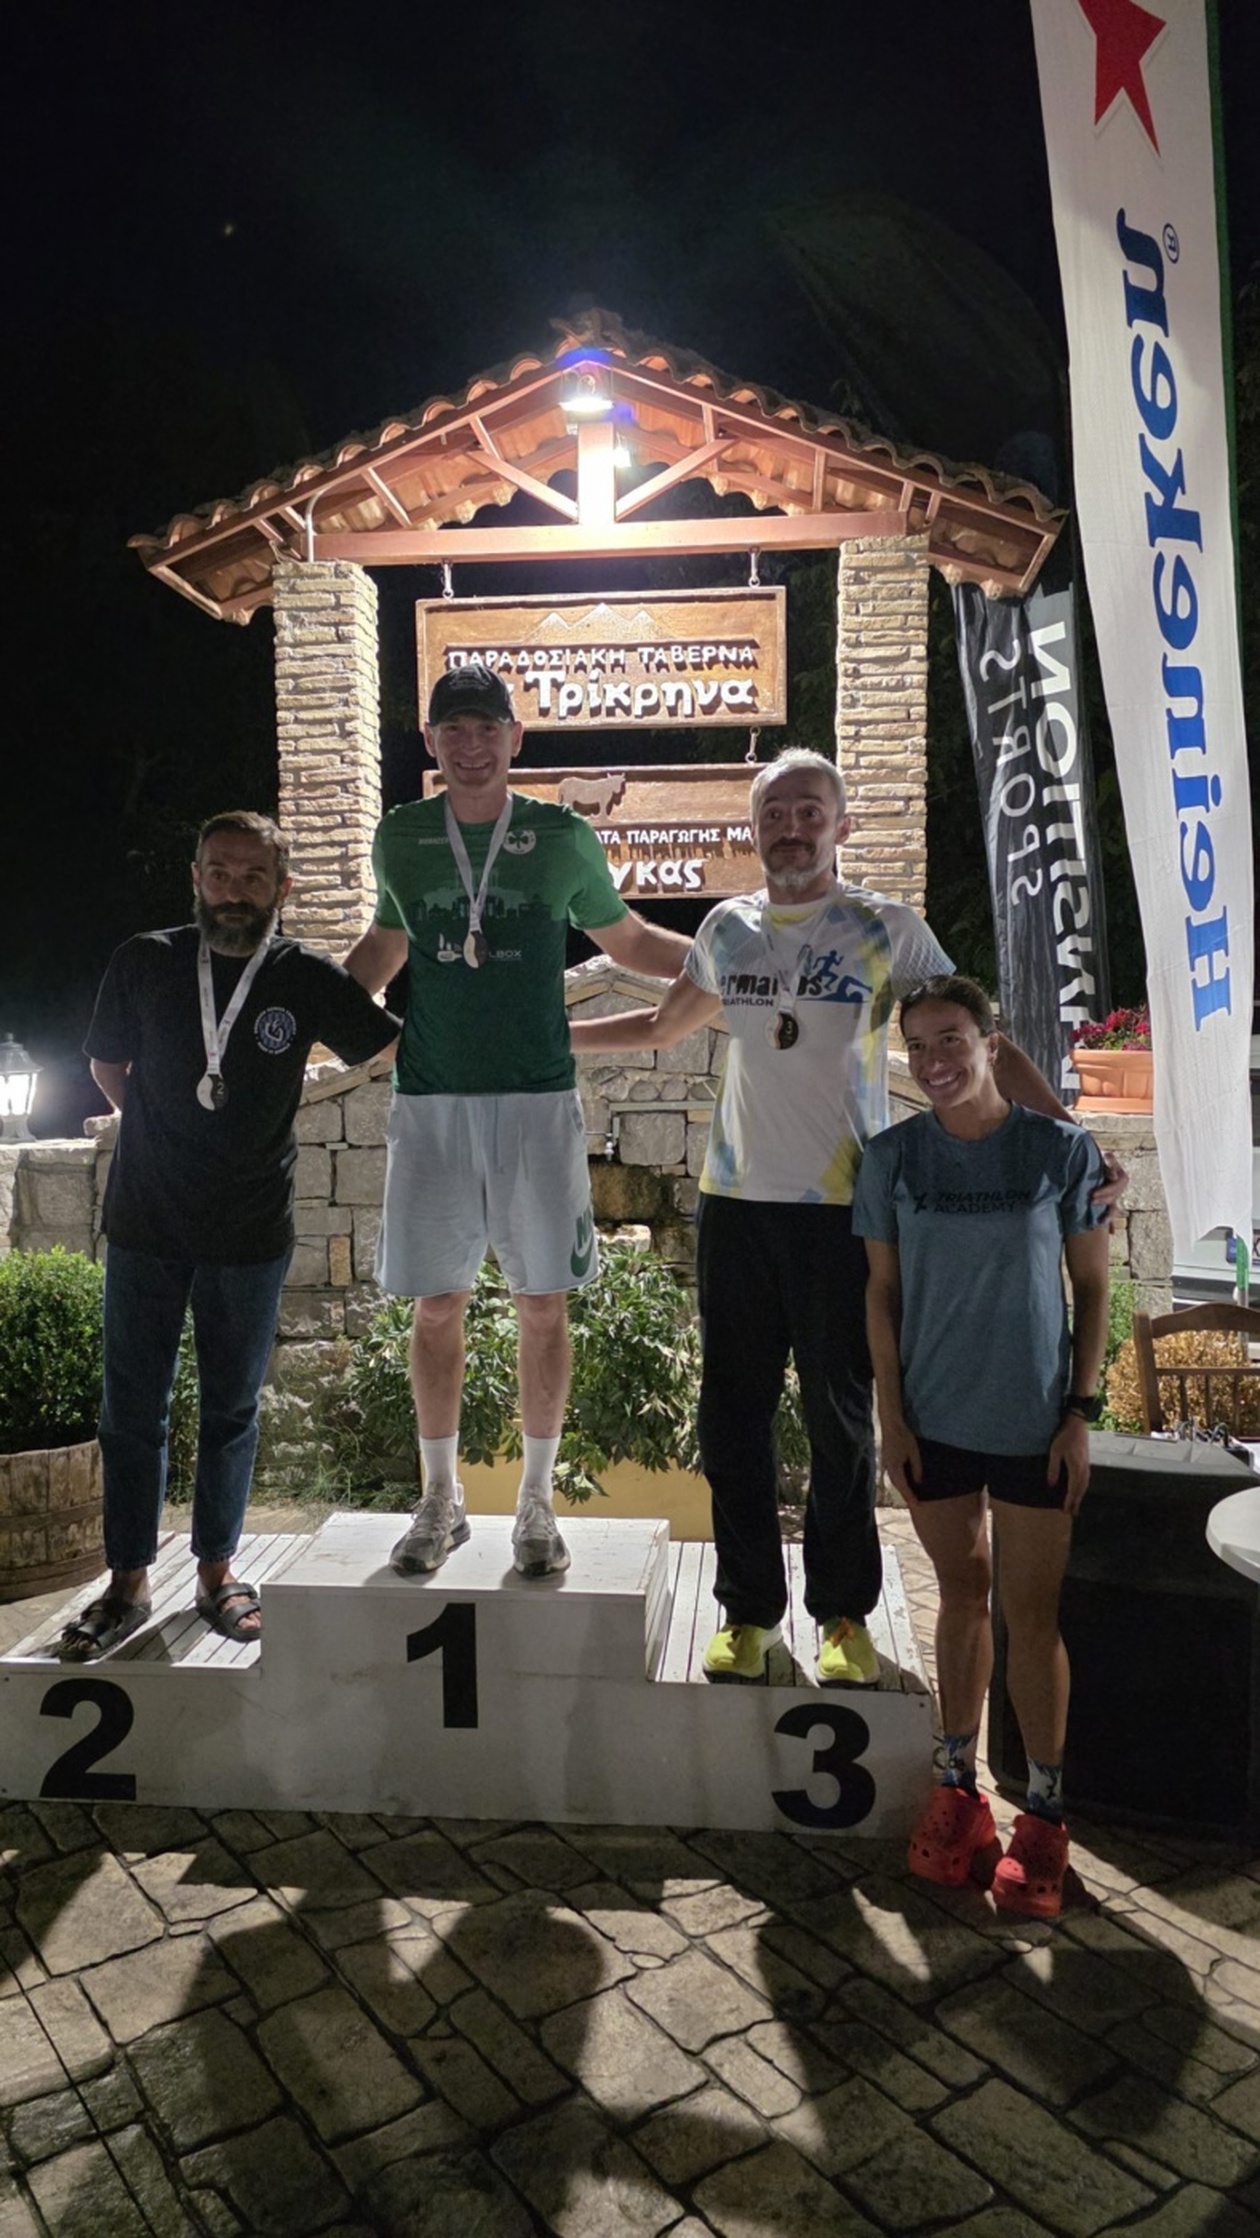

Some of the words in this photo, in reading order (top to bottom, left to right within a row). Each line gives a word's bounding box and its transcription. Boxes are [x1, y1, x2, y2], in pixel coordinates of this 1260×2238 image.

[448, 648, 625, 669] ΠΑΡΑΔΟΣΙΑΚΗ
[637, 645, 754, 664] ΤΑΒΕΡΝΑ
[525, 668, 754, 717] Τρίκρηνα
[626, 828, 721, 844] ΠΑΡΑΓΩΓΗΣ
[727, 826, 752, 841] ΜΑ
[217, 1082, 225, 1095] 2
[934, 1201, 1016, 1214] ACADEMY
[937, 1190, 1031, 1202] TRIATHLON
[406, 1603, 478, 1728] 1
[38, 1678, 137, 1800] 2
[771, 1703, 877, 1828] 3
